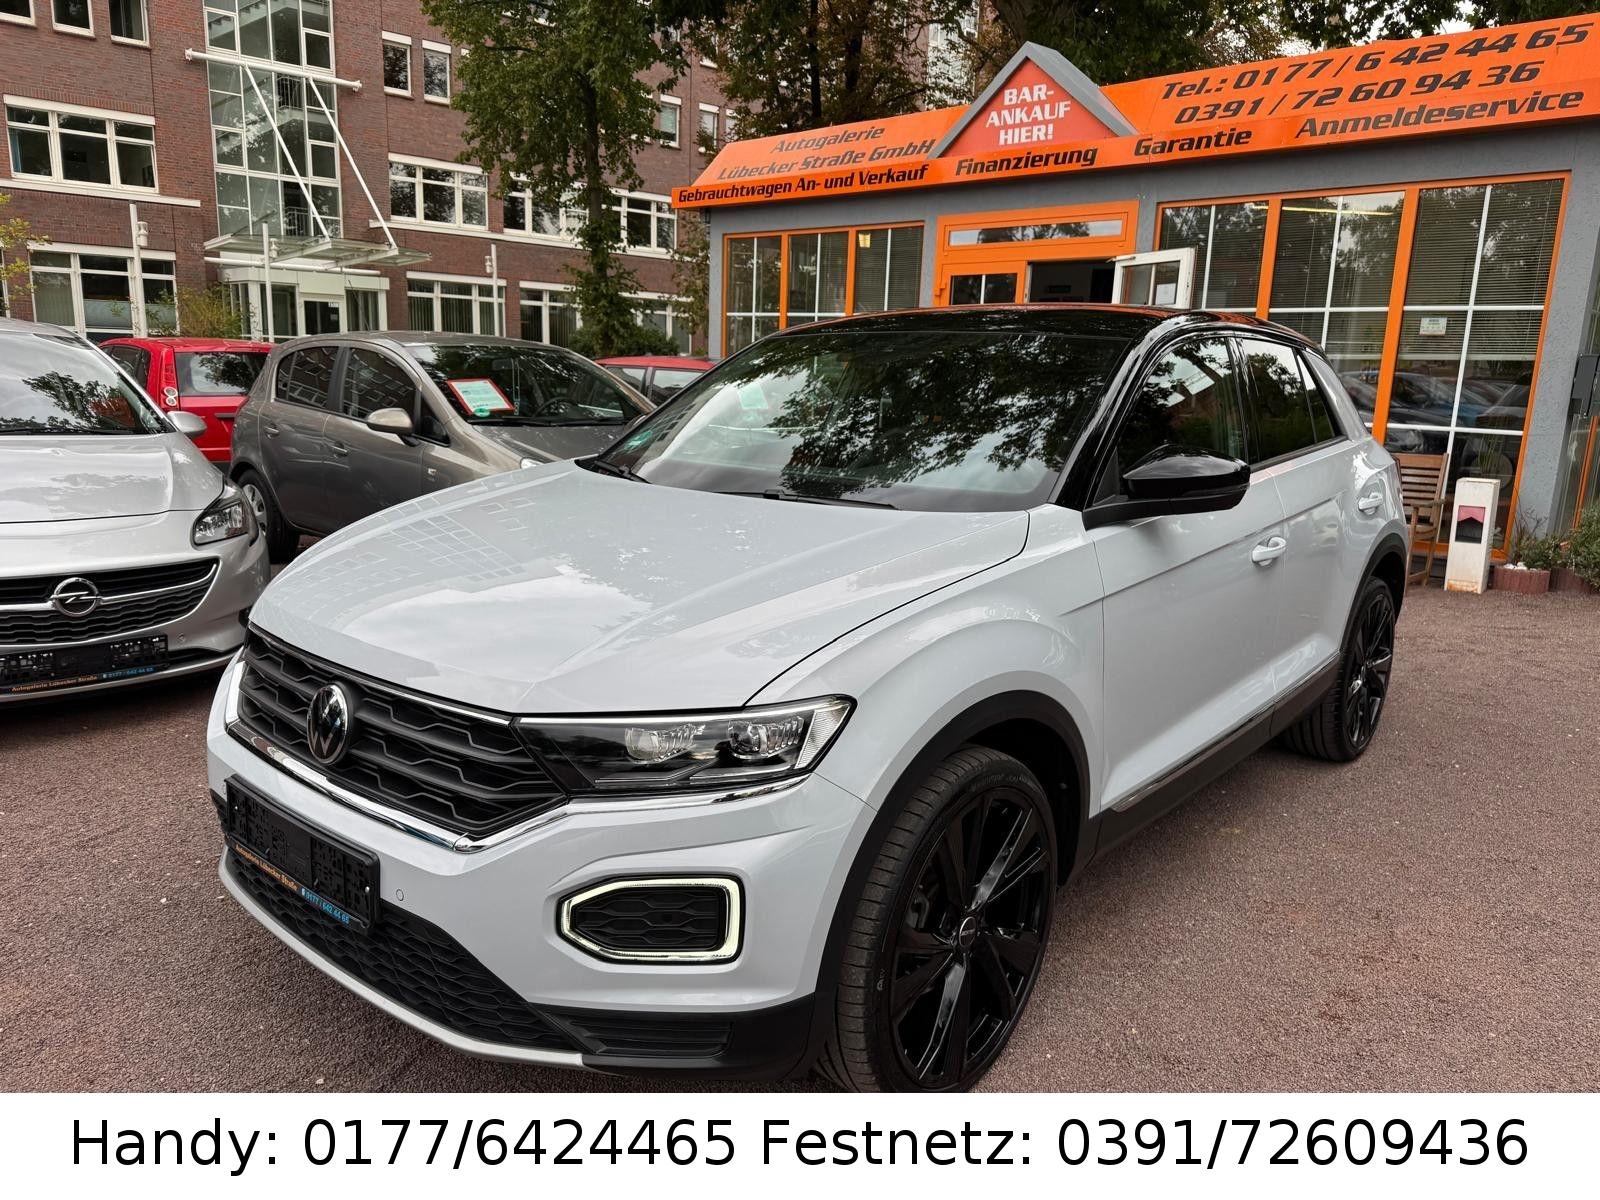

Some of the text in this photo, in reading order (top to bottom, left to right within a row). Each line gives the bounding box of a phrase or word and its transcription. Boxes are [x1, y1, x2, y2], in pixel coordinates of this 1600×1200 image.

[1163, 77, 1228, 99] Tel.:
[1233, 58, 1333, 89] 0177
[1390, 43, 1450, 66] 42
[1455, 33, 1519, 57] 44
[1525, 22, 1594, 50] 65
[1003, 84, 1054, 106] BAR-
[1174, 97, 1264, 124] 0391
[1292, 88, 1343, 110] 72
[1348, 78, 1406, 103] 60
[1411, 70, 1472, 95] 94
[1478, 60, 1545, 87] 36
[985, 101, 1071, 128] ANKAUF
[1296, 90, 1585, 138] Anmeldeservice
[770, 126, 886, 153] Autogalerie
[998, 124, 1054, 146] HIER!
[1134, 127, 1252, 157] Garantie
[717, 139, 936, 180] Lübecker Straße GmbH
[955, 147, 1099, 176] Finanzierung
[678, 164, 929, 203] Gebrauchtwagen An- und Verkauf
